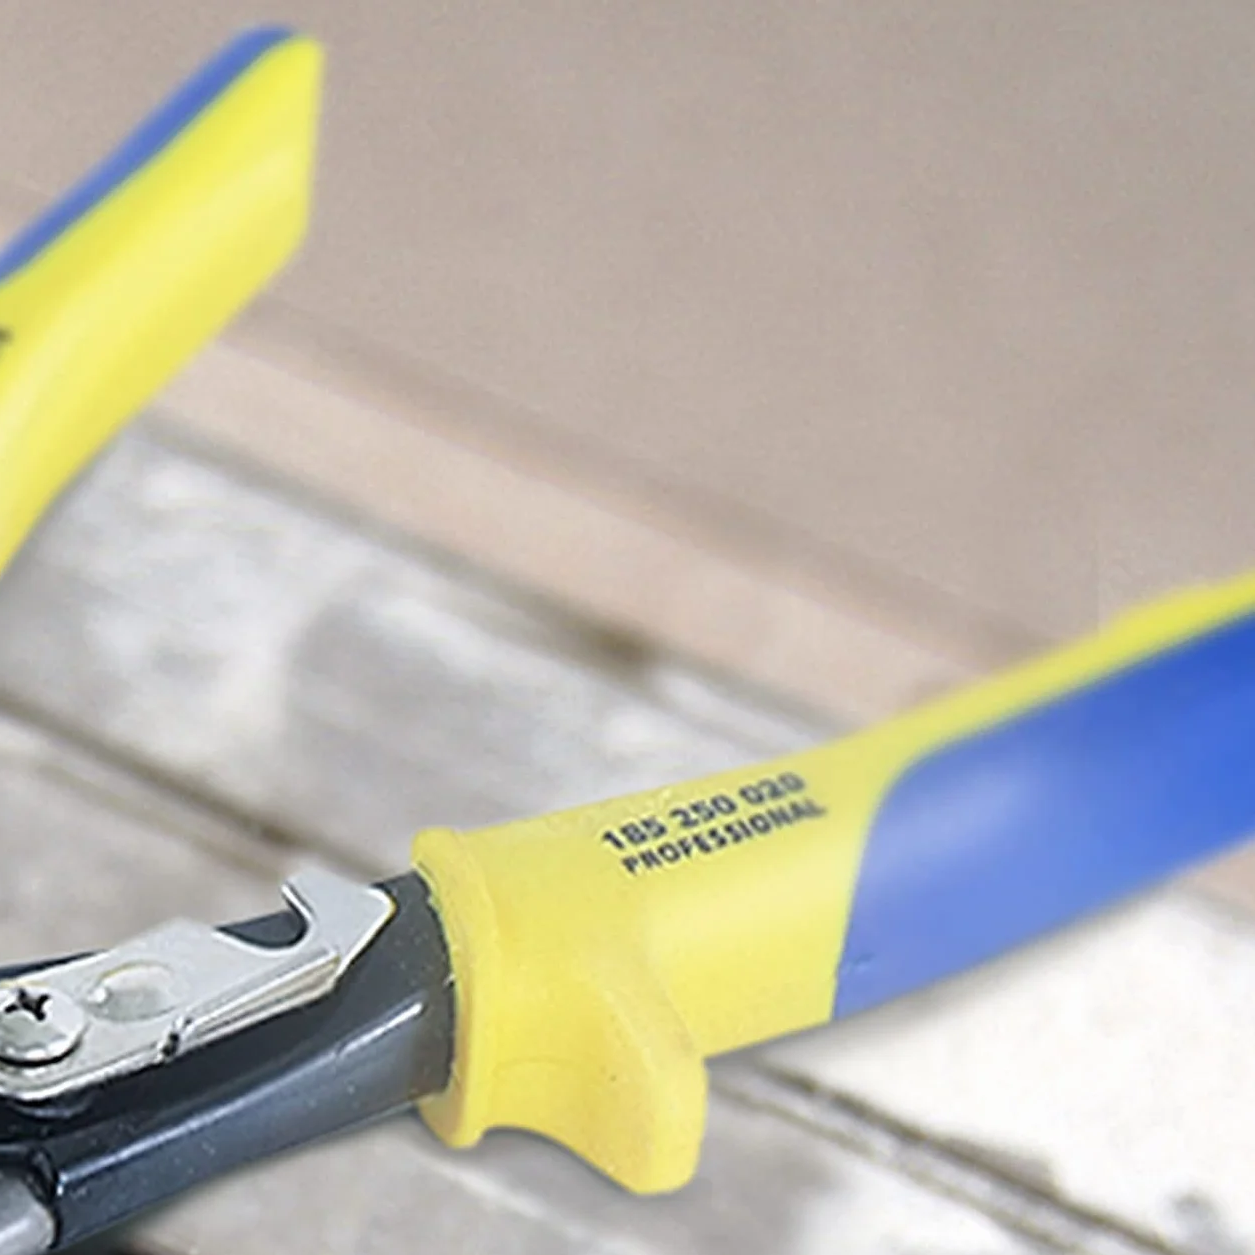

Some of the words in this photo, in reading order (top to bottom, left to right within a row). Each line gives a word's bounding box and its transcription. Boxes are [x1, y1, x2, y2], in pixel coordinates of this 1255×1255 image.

[602, 816, 667, 850] 185
[669, 794, 737, 828] 250
[739, 770, 805, 804] 020
[621, 799, 826, 875] PROFESSIONAL
